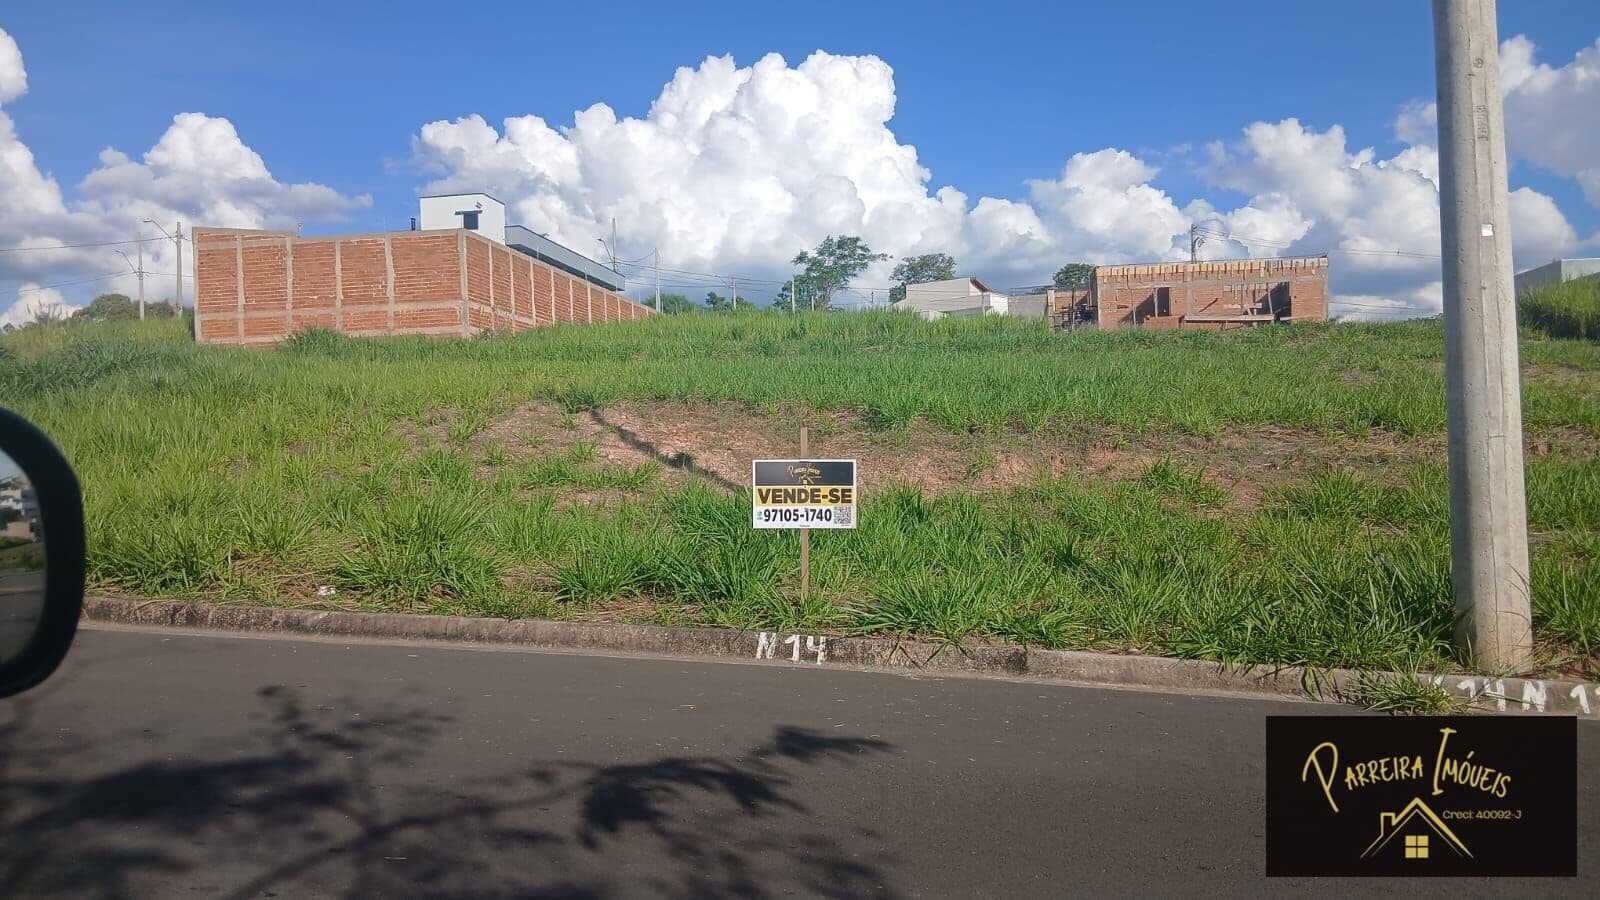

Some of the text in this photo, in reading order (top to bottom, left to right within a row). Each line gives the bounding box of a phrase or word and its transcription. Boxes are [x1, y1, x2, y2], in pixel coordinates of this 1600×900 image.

[757, 488, 852, 504] VENDE-SE
[763, 508, 832, 522] 97105-1740
[784, 634, 827, 665] 14
[1522, 679, 1547, 713] N
[1569, 684, 1600, 715] 1
